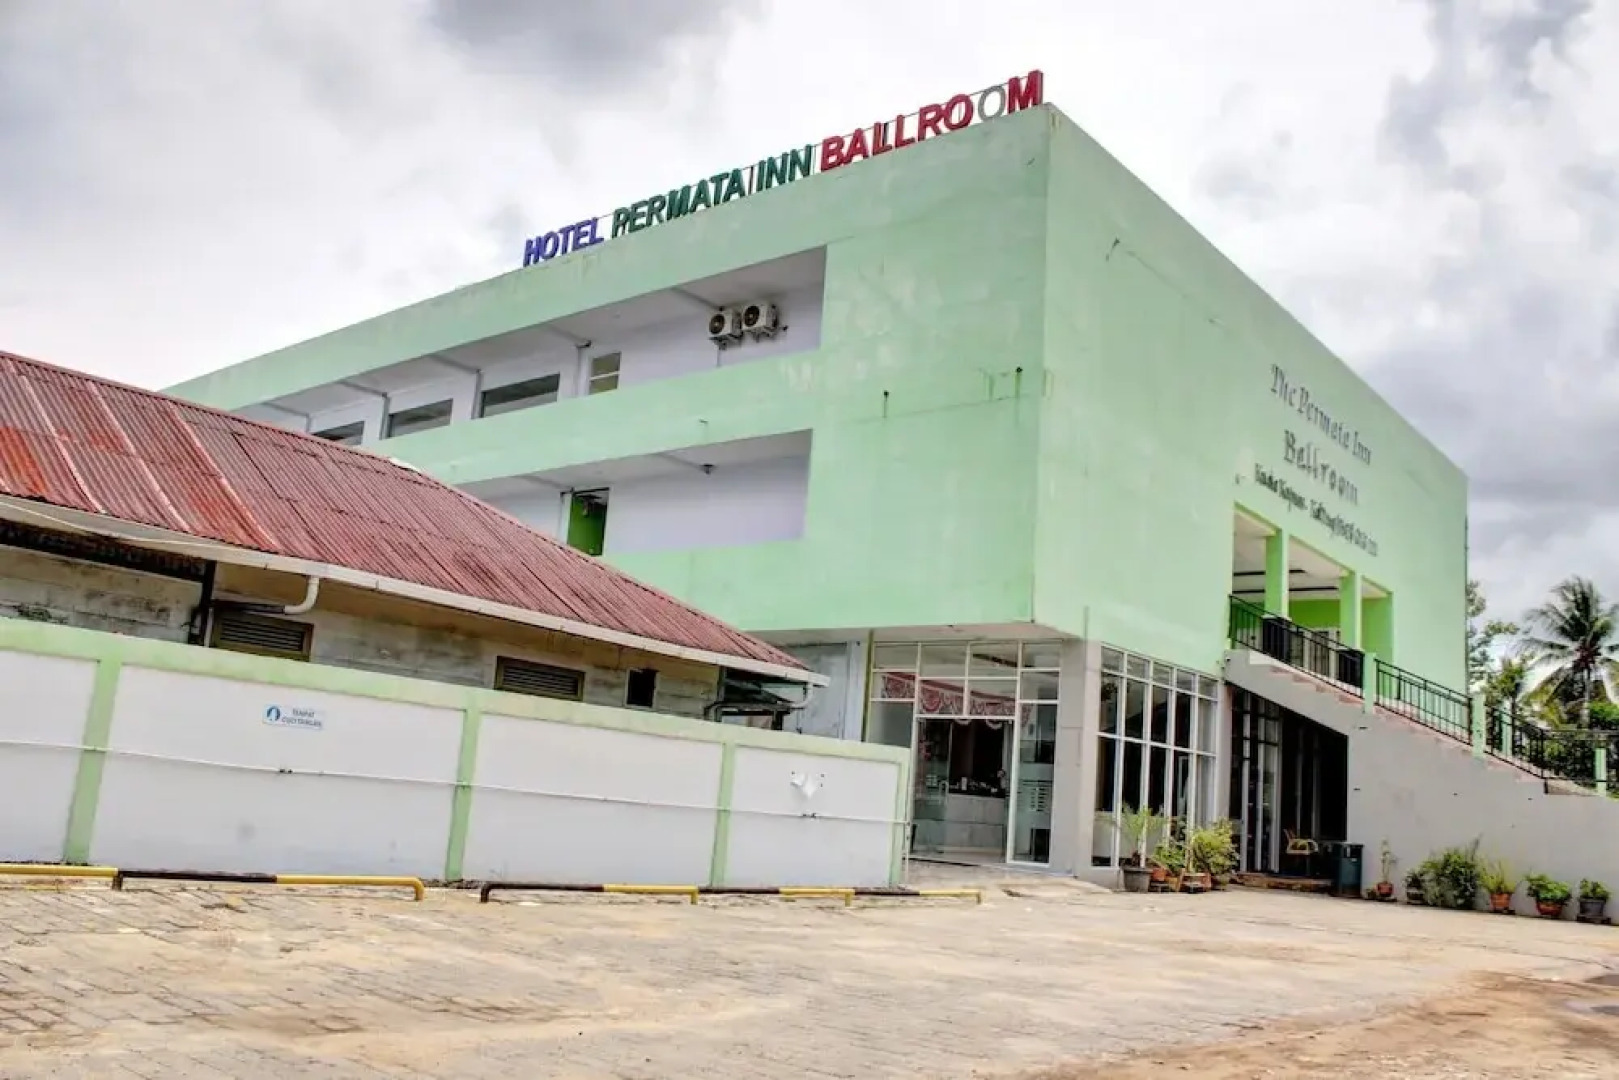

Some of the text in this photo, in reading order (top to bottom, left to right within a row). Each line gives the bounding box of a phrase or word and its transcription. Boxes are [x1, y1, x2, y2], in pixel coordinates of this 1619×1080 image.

[522, 69, 1043, 267] HOTEL PERMATA INN BALLROOM
[1270, 363, 1298, 407] The
[1352, 430, 1372, 466] Inn
[1283, 428, 1359, 506] Ballroom
